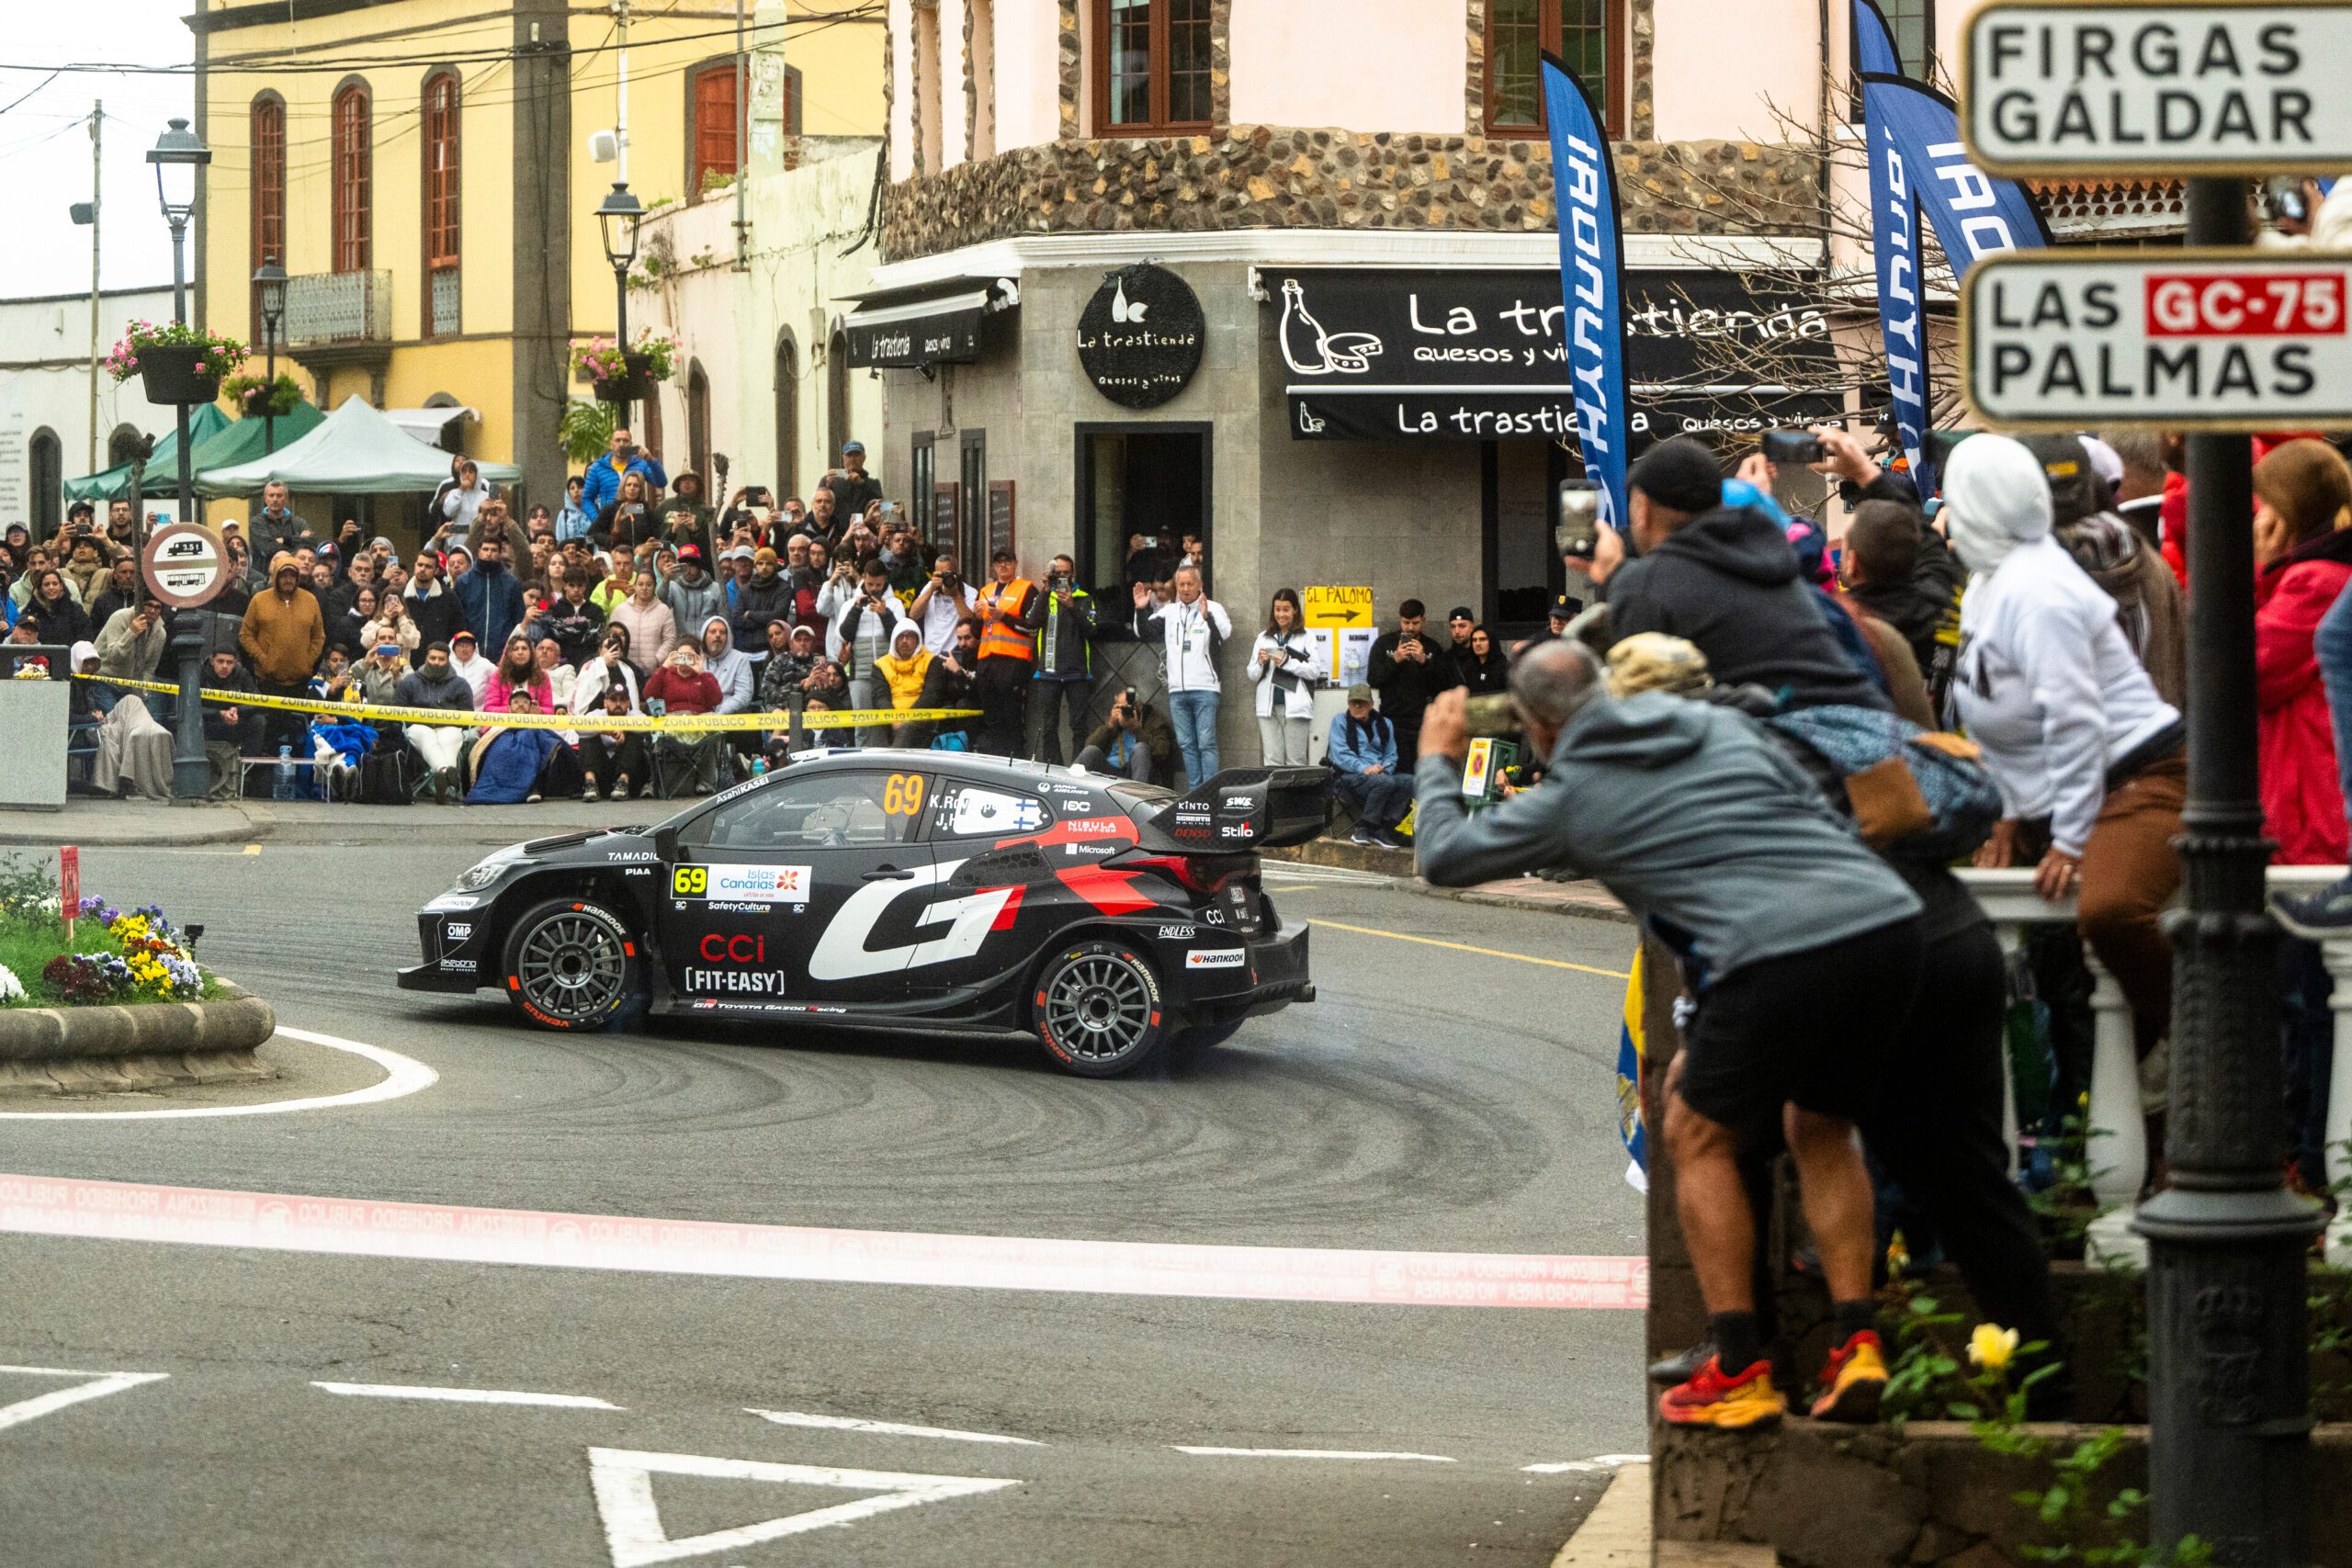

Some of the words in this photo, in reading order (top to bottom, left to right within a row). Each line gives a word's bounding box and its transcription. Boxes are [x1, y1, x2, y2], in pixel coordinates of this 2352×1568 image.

[1989, 22, 2301, 79] FIRGAS
[1567, 134, 1609, 454] HYUNDAI
[1992, 280, 2120, 329] LAS
[2152, 279, 2342, 331] GC-75
[1410, 294, 1477, 336] La
[872, 333, 879, 359] La
[1078, 330, 1096, 348] La
[1103, 331, 1194, 347] trastienda
[1522, 348, 1537, 367] y
[1992, 343, 2315, 398] PALMAS
[1142, 379, 1148, 389] y
[1153, 375, 1182, 383] vinos
[1398, 403, 1439, 434] La
[182, 543, 195, 551] 3.5
[1327, 588, 1374, 604] PALOMO
[219, 690, 269, 703] PUBLICO
[280, 696, 314, 708] ZONA
[317, 701, 366, 714] PUBLICO
[377, 705, 409, 716] ZONA
[413, 709, 460, 721] PUBLICO
[473, 714, 504, 723] ZONA
[507, 716, 557, 726] PUBLICO
[569, 717, 600, 727] ZONA
[603, 718, 651, 727] PUBLICO
[664, 718, 695, 728] ZONA
[697, 718, 746, 727] PUBLICO
[757, 716, 790, 726] ZONA
[884, 773, 923, 816] 69
[1175, 828, 1211, 839] DENSO
[1222, 822, 1253, 837] Stilo
[1079, 845, 1115, 854] Microsoft
[625, 867, 651, 875] PIAA
[747, 869, 776, 879] Islas
[674, 868, 707, 894] 69
[720, 877, 775, 890] Canarias
[675, 900, 687, 909] SC
[793, 904, 805, 912] SC
[447, 925, 471, 937] OMP
[1159, 926, 1195, 937] ENDLESS
